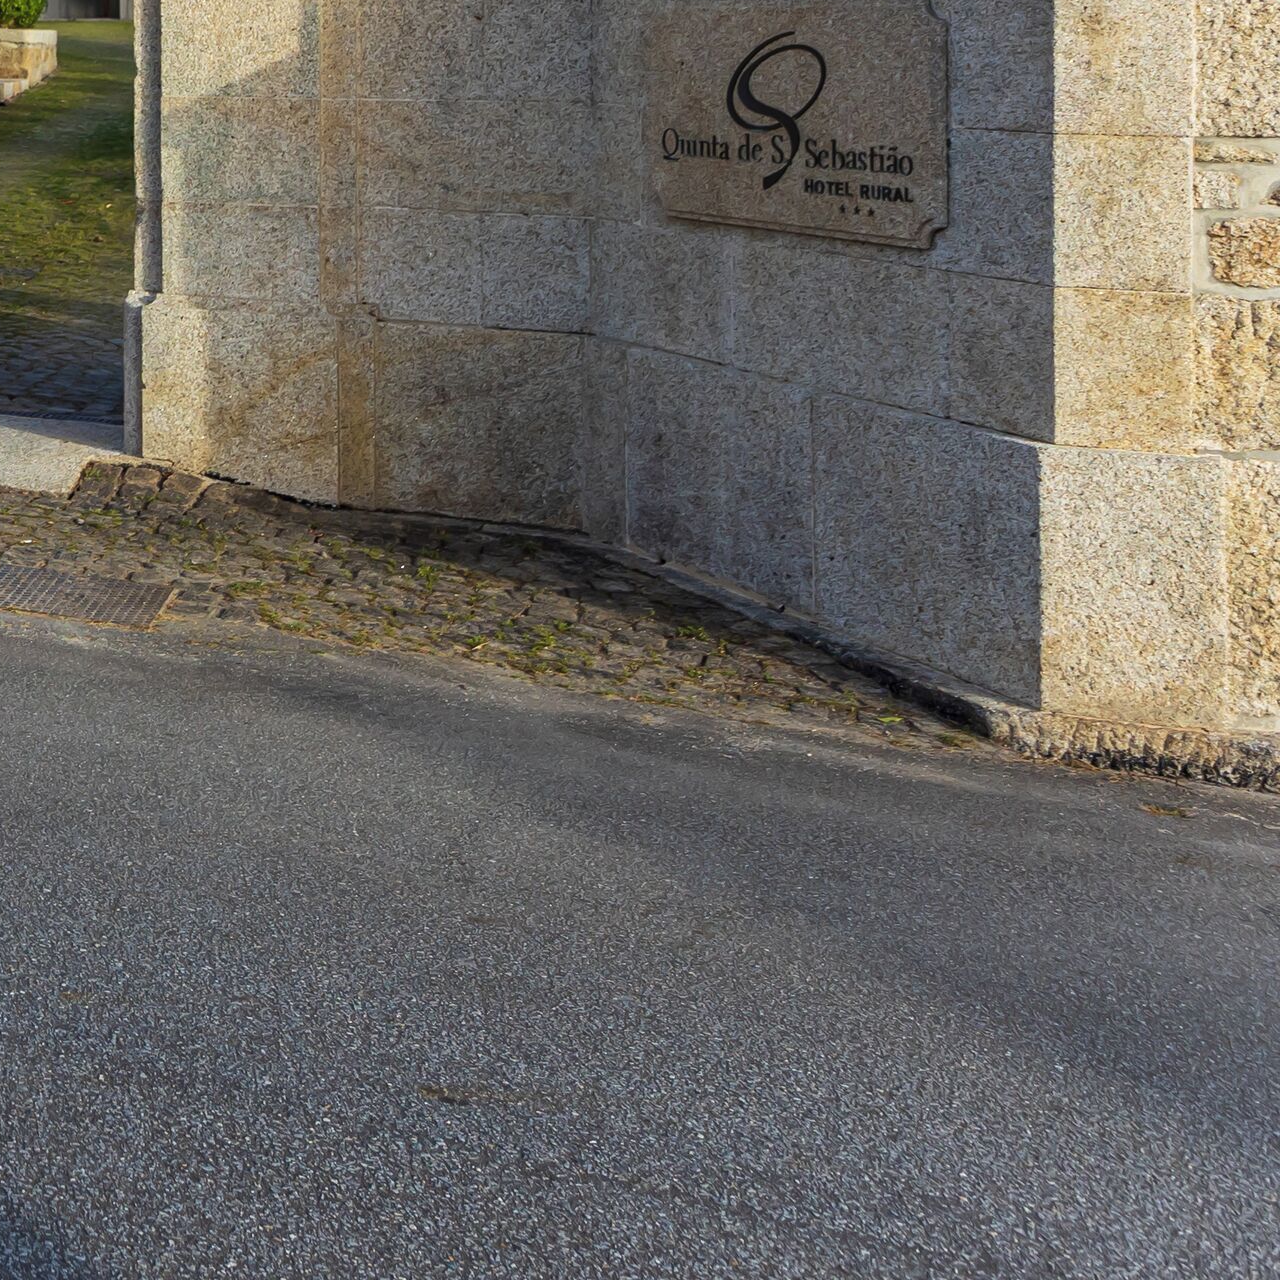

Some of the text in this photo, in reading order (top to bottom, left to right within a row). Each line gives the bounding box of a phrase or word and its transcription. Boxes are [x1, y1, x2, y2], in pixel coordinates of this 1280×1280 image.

[662, 127, 730, 161] Quinta
[738, 133, 763, 162] de
[805, 138, 914, 176] Sebastião
[804, 178, 914, 203] HOTEL RURAL
